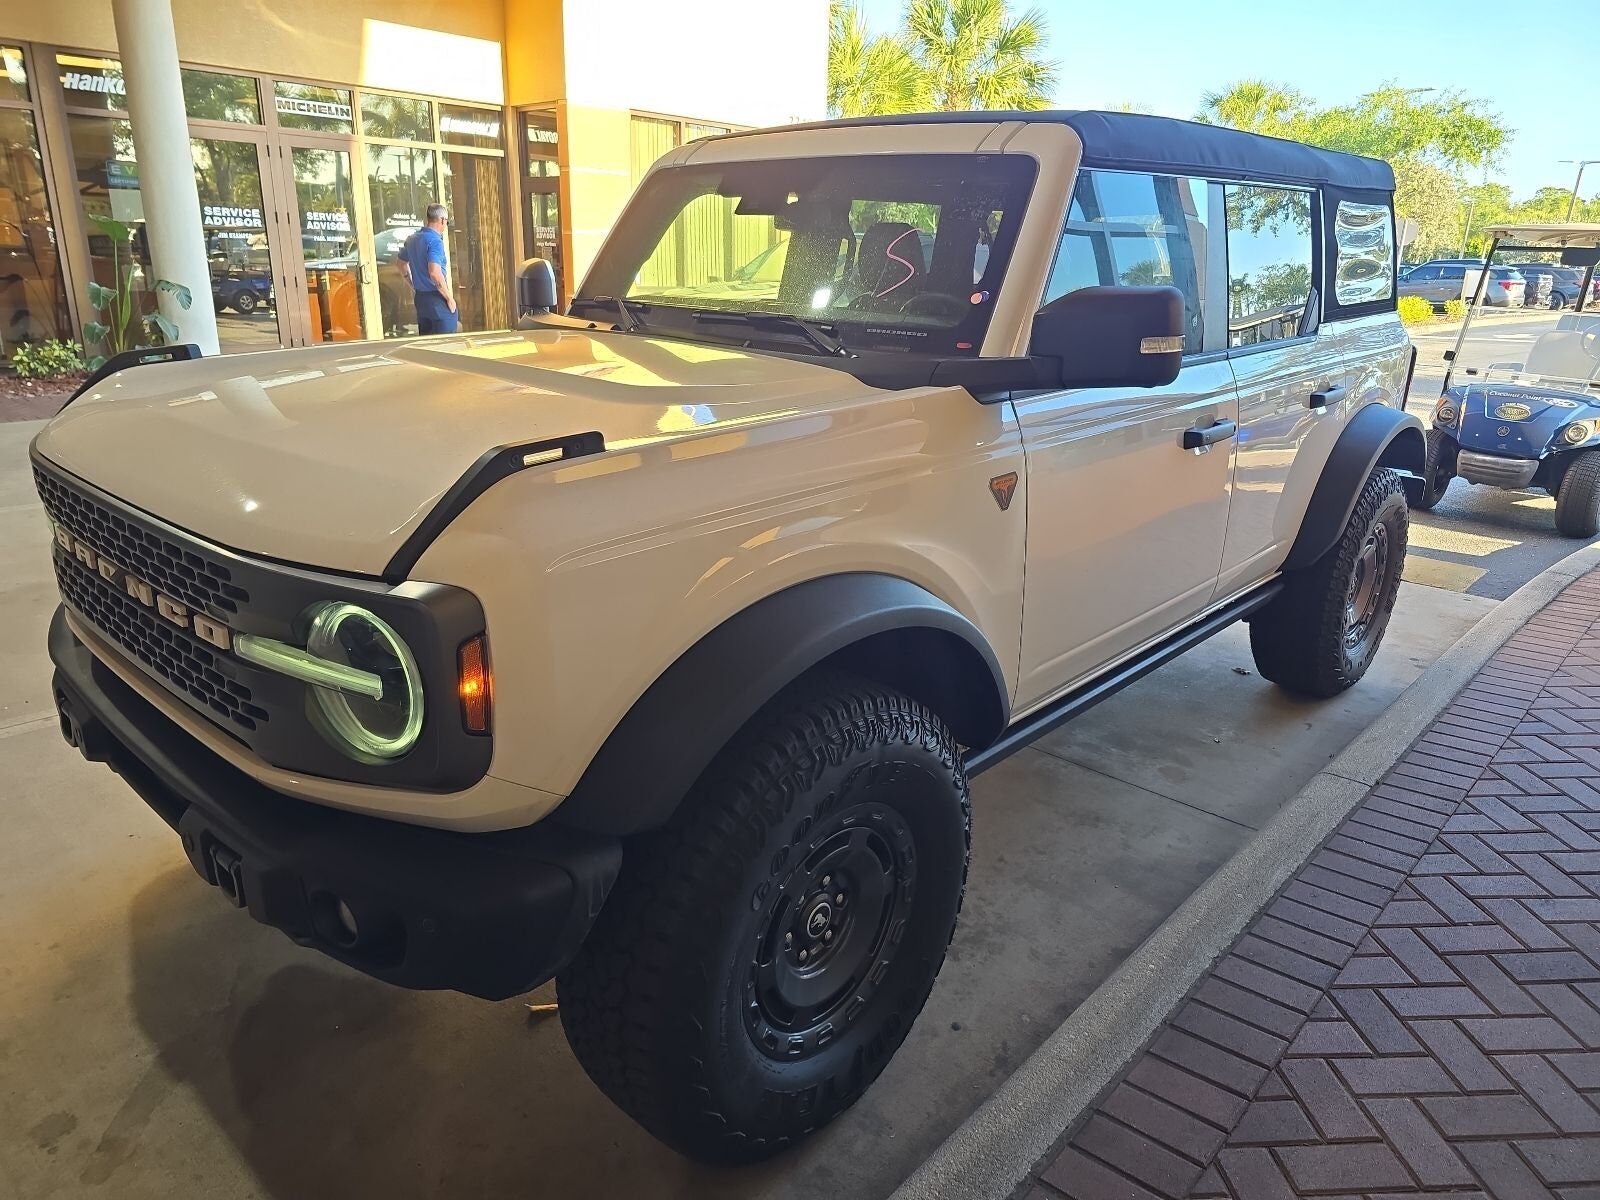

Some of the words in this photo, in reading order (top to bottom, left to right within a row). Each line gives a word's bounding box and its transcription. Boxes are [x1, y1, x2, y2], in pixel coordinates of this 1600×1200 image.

[63, 72, 127, 95] Hanko
[276, 99, 350, 117] MICHELIN
[204, 206, 261, 218] SERVICE
[306, 211, 349, 222] SERVICE
[204, 216, 263, 228] ADVISOR
[306, 220, 351, 231] ADVISOR
[1489, 390, 1520, 398] Coconut
[1521, 393, 1543, 401] Point
[55, 525, 230, 650] BRONCO
